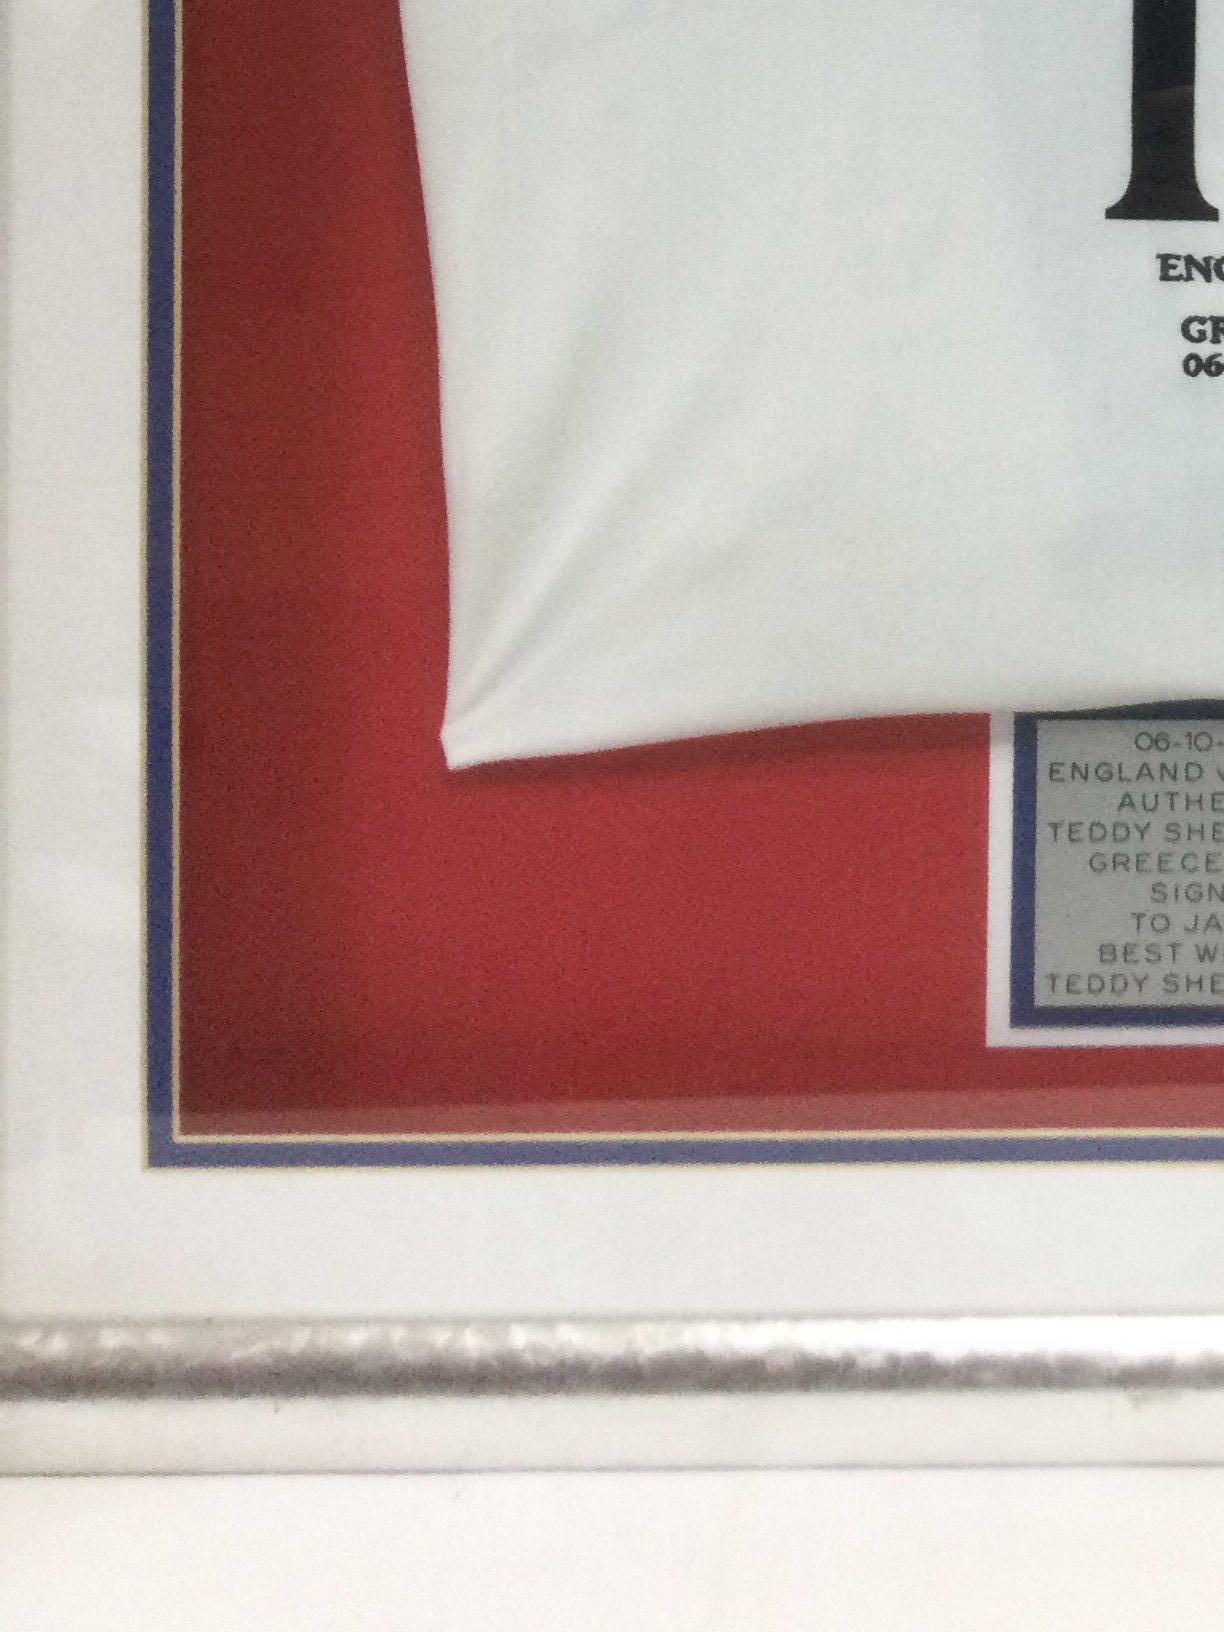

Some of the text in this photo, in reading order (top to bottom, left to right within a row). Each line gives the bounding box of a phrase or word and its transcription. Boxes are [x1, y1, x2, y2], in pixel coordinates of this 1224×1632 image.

[1048, 762, 1202, 784] ENGLAND
[1048, 822, 1151, 844] TEDDY
[1088, 853, 1224, 874] GREECE
[1132, 913, 1170, 934] TO
[1099, 943, 1181, 965] BEST
[1047, 973, 1148, 995] TEDDY
